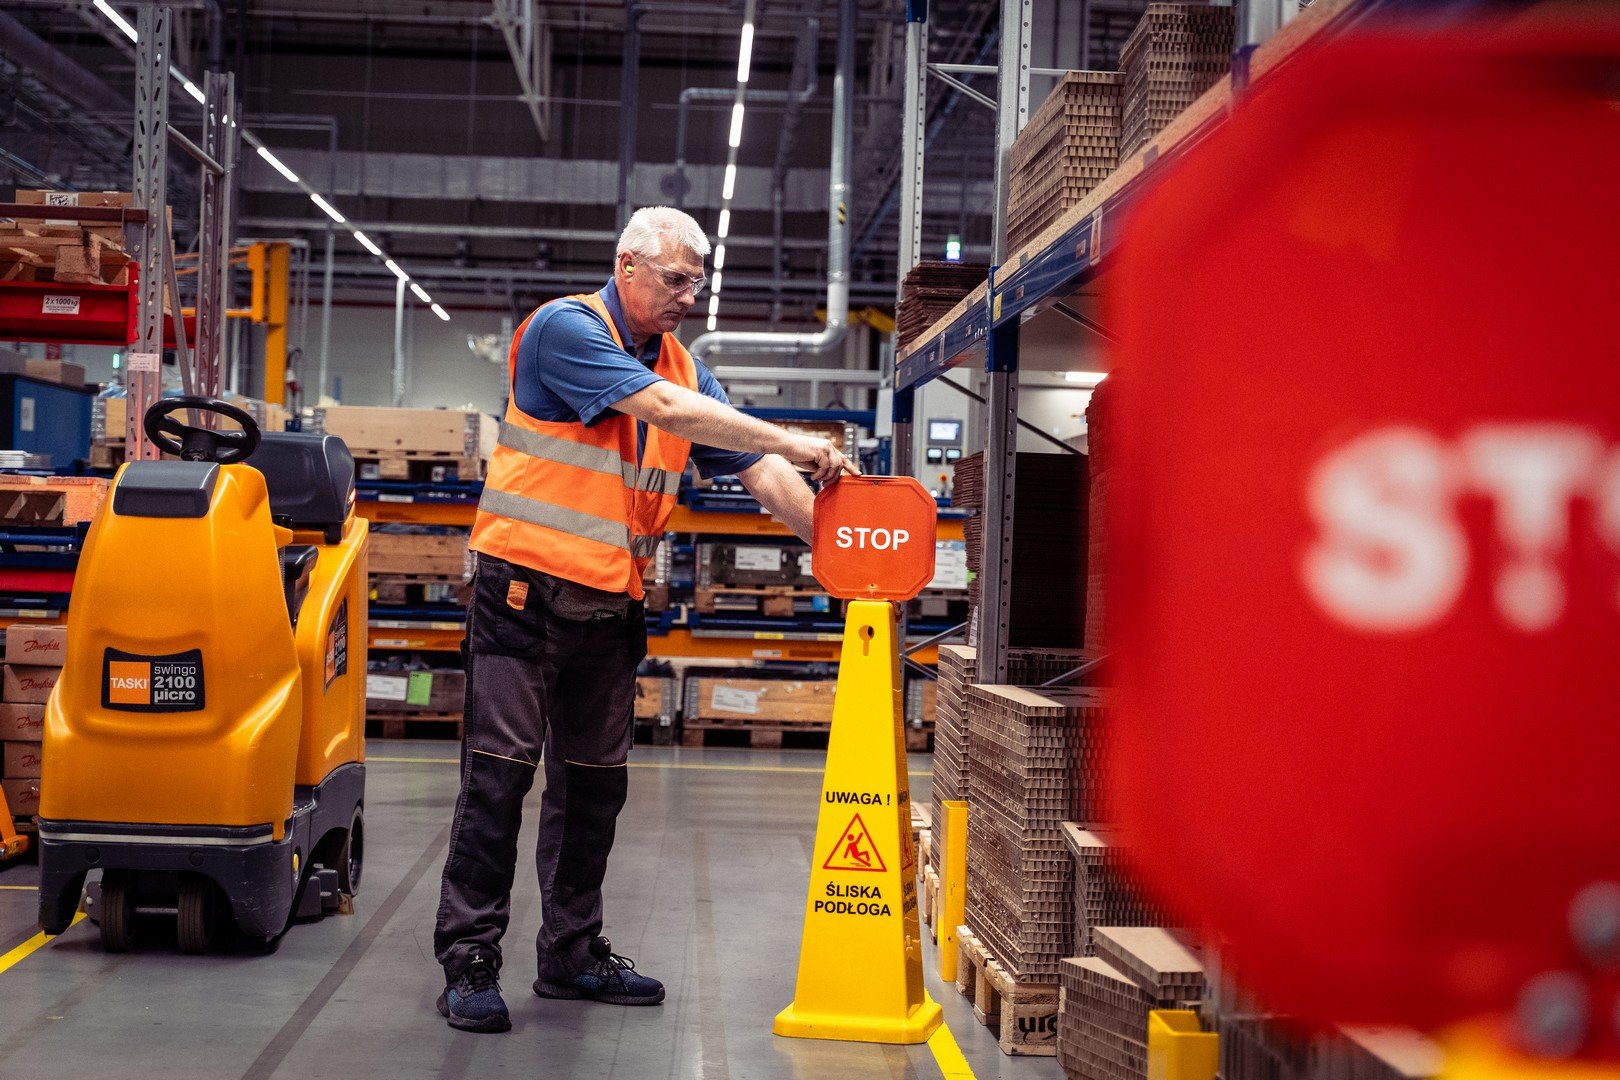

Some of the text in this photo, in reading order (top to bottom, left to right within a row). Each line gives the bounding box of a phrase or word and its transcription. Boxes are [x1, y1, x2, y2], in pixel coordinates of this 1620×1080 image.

[1302, 423, 1620, 633] ST
[835, 526, 910, 551] STOP
[154, 664, 196, 676] swingo
[110, 677, 148, 690] TASKI
[154, 676, 196, 689] 2100
[825, 791, 882, 805] UWAGA
[825, 881, 882, 899] ŚLISKA
[814, 900, 892, 917] PODŁOGA
